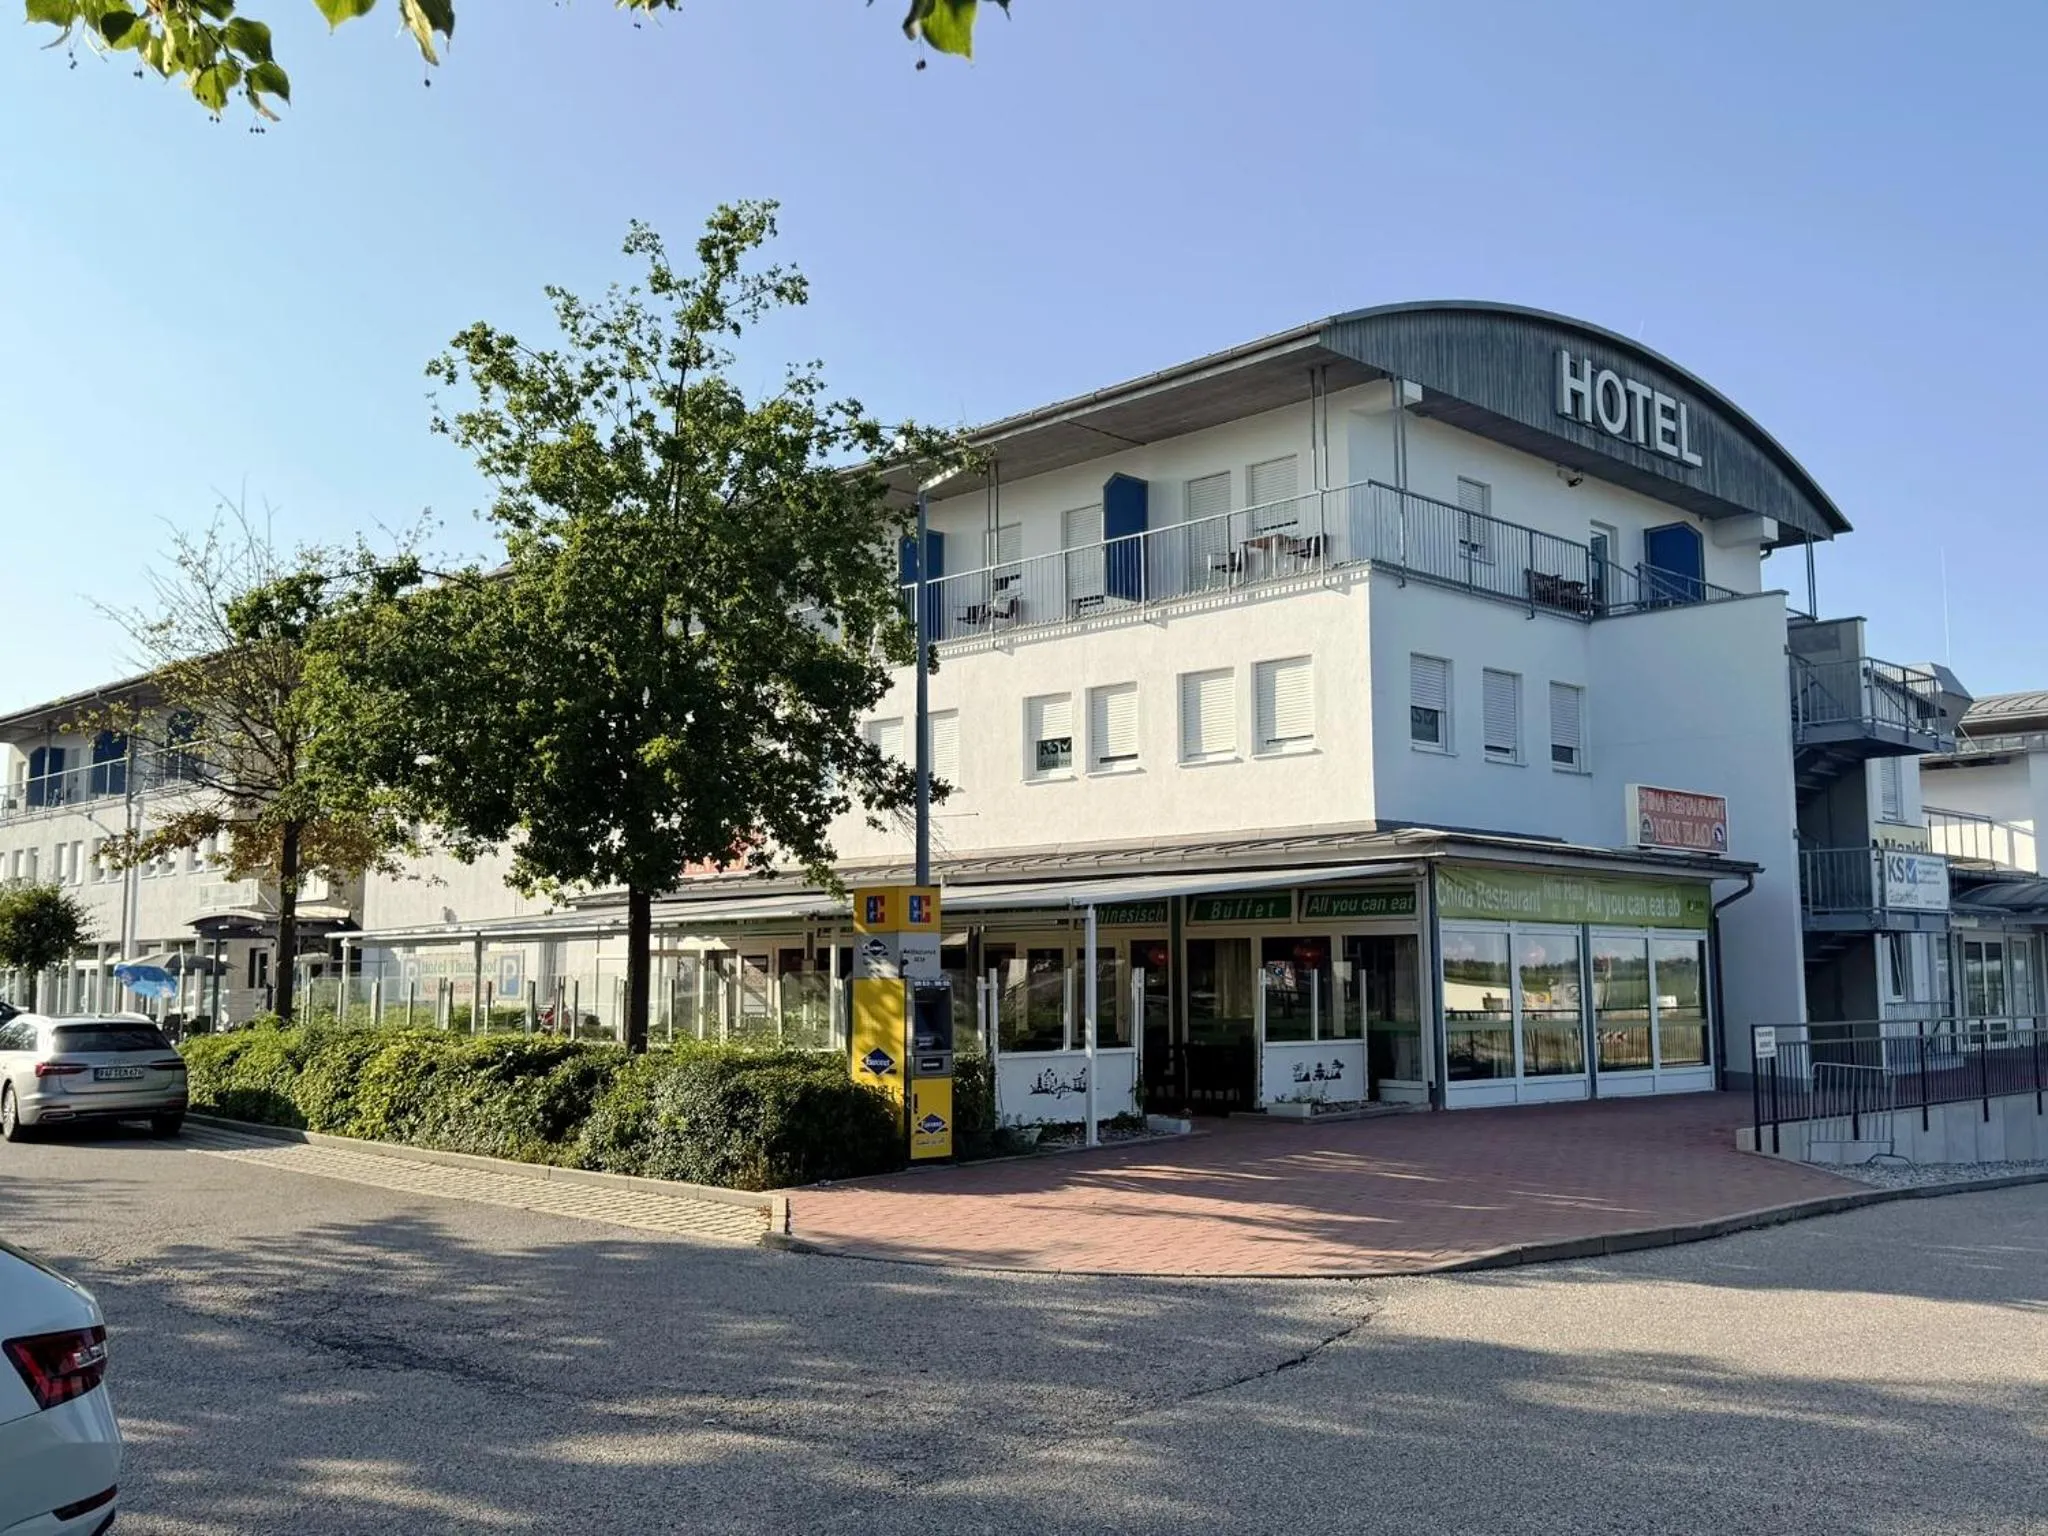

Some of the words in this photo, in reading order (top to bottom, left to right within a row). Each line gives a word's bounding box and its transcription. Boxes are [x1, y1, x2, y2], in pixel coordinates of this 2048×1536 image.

[1558, 350, 1702, 467] HOTEL
[1887, 855, 1904, 883] KS
[1309, 896, 1329, 913] All
[1332, 898, 1358, 915] you
[1361, 898, 1386, 912] can
[1391, 895, 1414, 911] eat
[1436, 877, 1473, 910] China
[1475, 881, 1541, 912] Restaurant
[1586, 884, 1600, 913] All
[1602, 893, 1626, 920] you
[1627, 896, 1647, 917] can
[1649, 896, 1666, 917] eat
